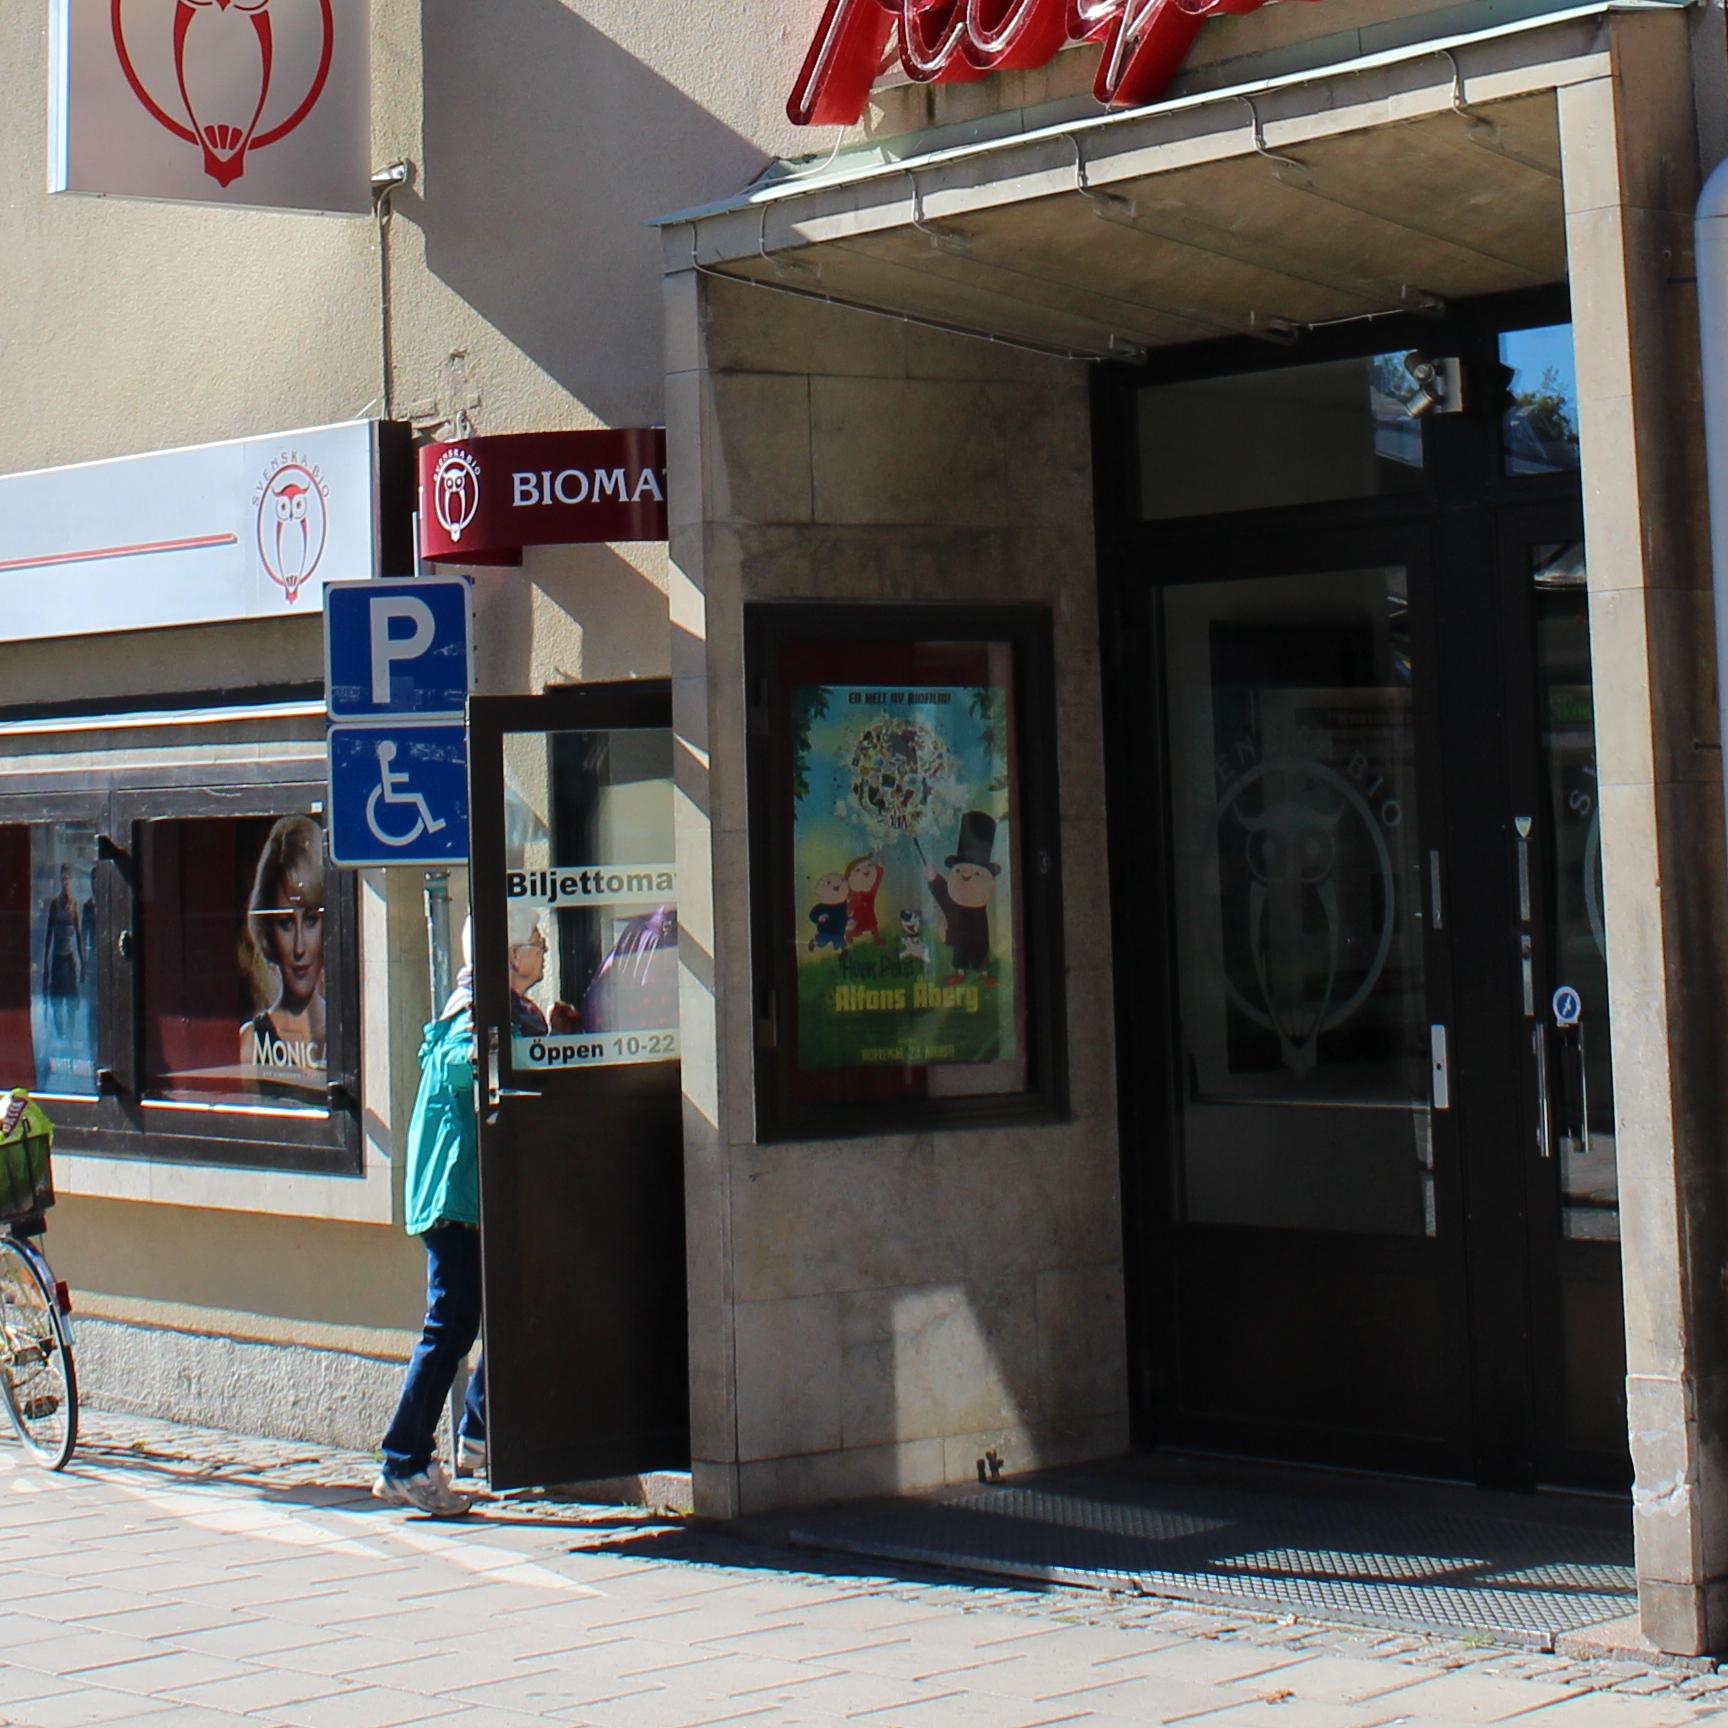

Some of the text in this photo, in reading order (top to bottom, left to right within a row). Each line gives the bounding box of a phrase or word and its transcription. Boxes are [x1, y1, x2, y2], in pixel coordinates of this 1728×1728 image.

[252, 450, 329, 506] SVENSKA BIO
[512, 468, 666, 507] BIOMA
[370, 596, 436, 704] P
[507, 870, 677, 903] Biljettoma
[835, 975, 979, 1013] Alfons Åberg
[529, 1034, 675, 1065] Öppen 10-22
